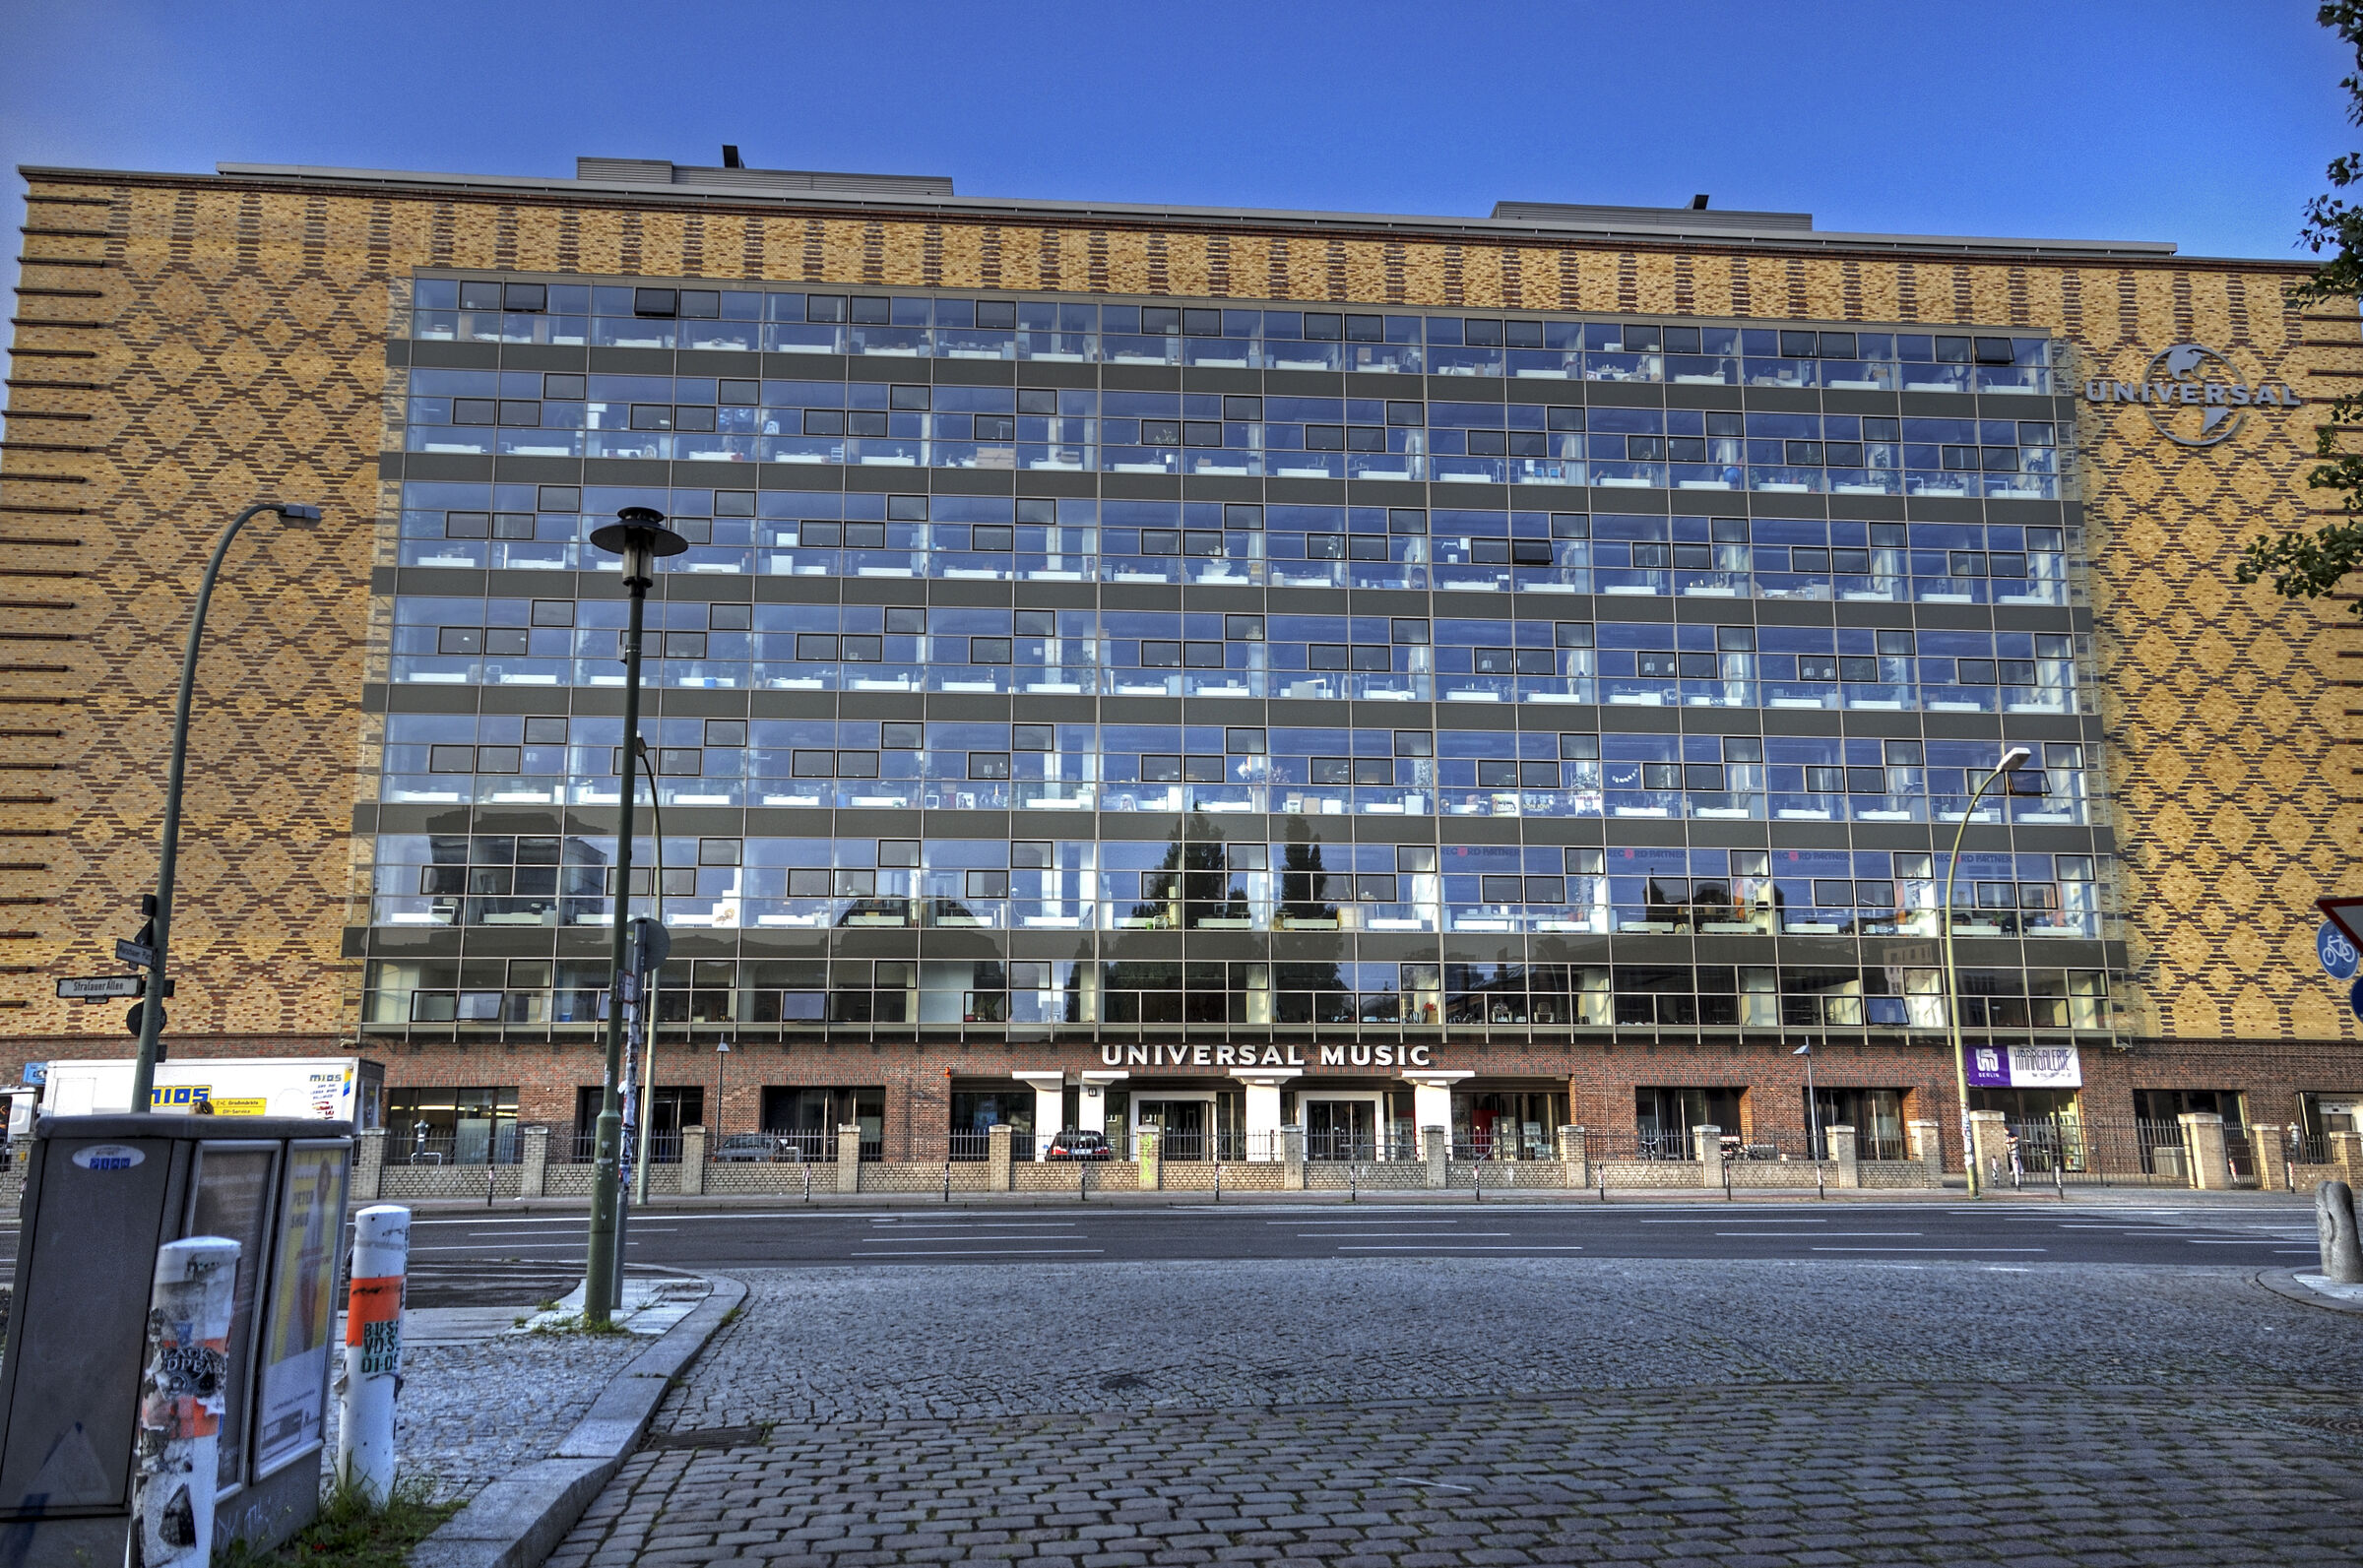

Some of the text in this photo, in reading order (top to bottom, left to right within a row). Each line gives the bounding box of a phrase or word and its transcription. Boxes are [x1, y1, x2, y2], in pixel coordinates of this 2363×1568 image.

[2085, 381, 2301, 407] UNIVERSAL
[1440, 847, 1521, 857] RECORD PARTNER
[1607, 848, 1688, 859] RECORD PARTNER
[1975, 854, 2012, 863] PARTNER
[73, 981, 124, 992] Stralauer Allee
[1101, 1044, 1431, 1067] UNIVERSAL MUSIC
